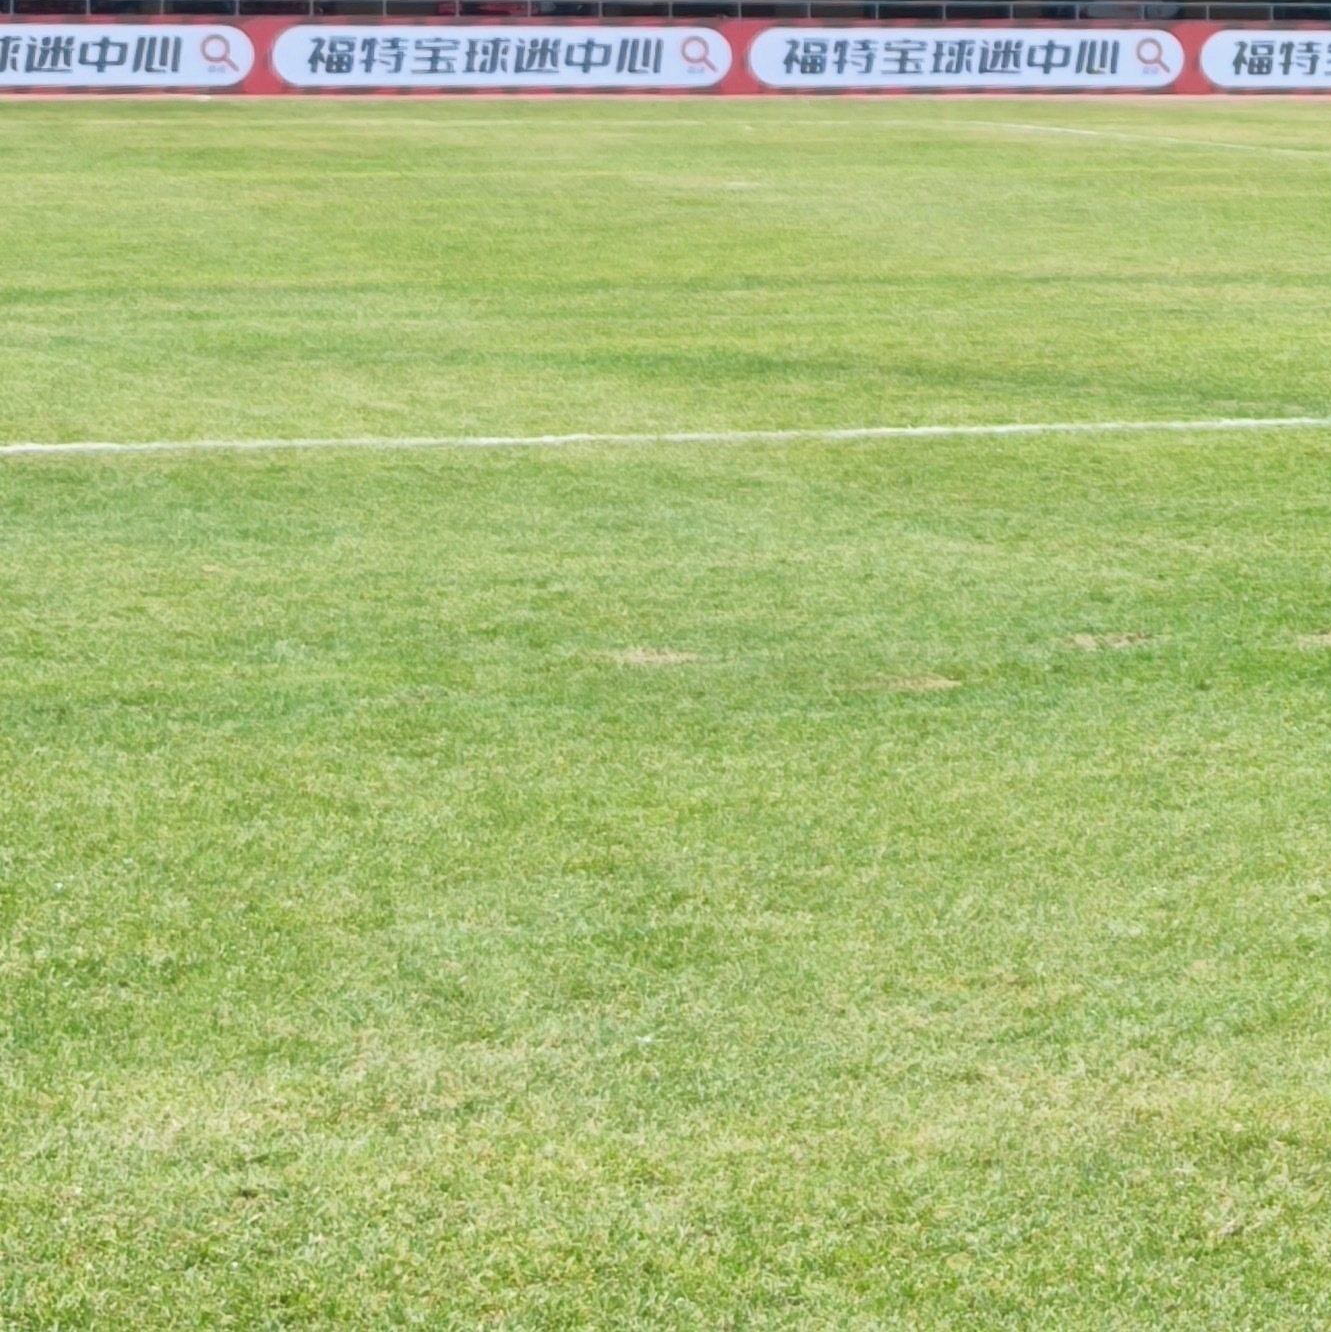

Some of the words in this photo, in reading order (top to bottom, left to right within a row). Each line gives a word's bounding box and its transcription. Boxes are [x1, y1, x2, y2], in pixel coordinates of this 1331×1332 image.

[307, 37, 664, 75] 福特宝球迷中心
[782, 38, 1120, 75] 福特宝球迷中心
